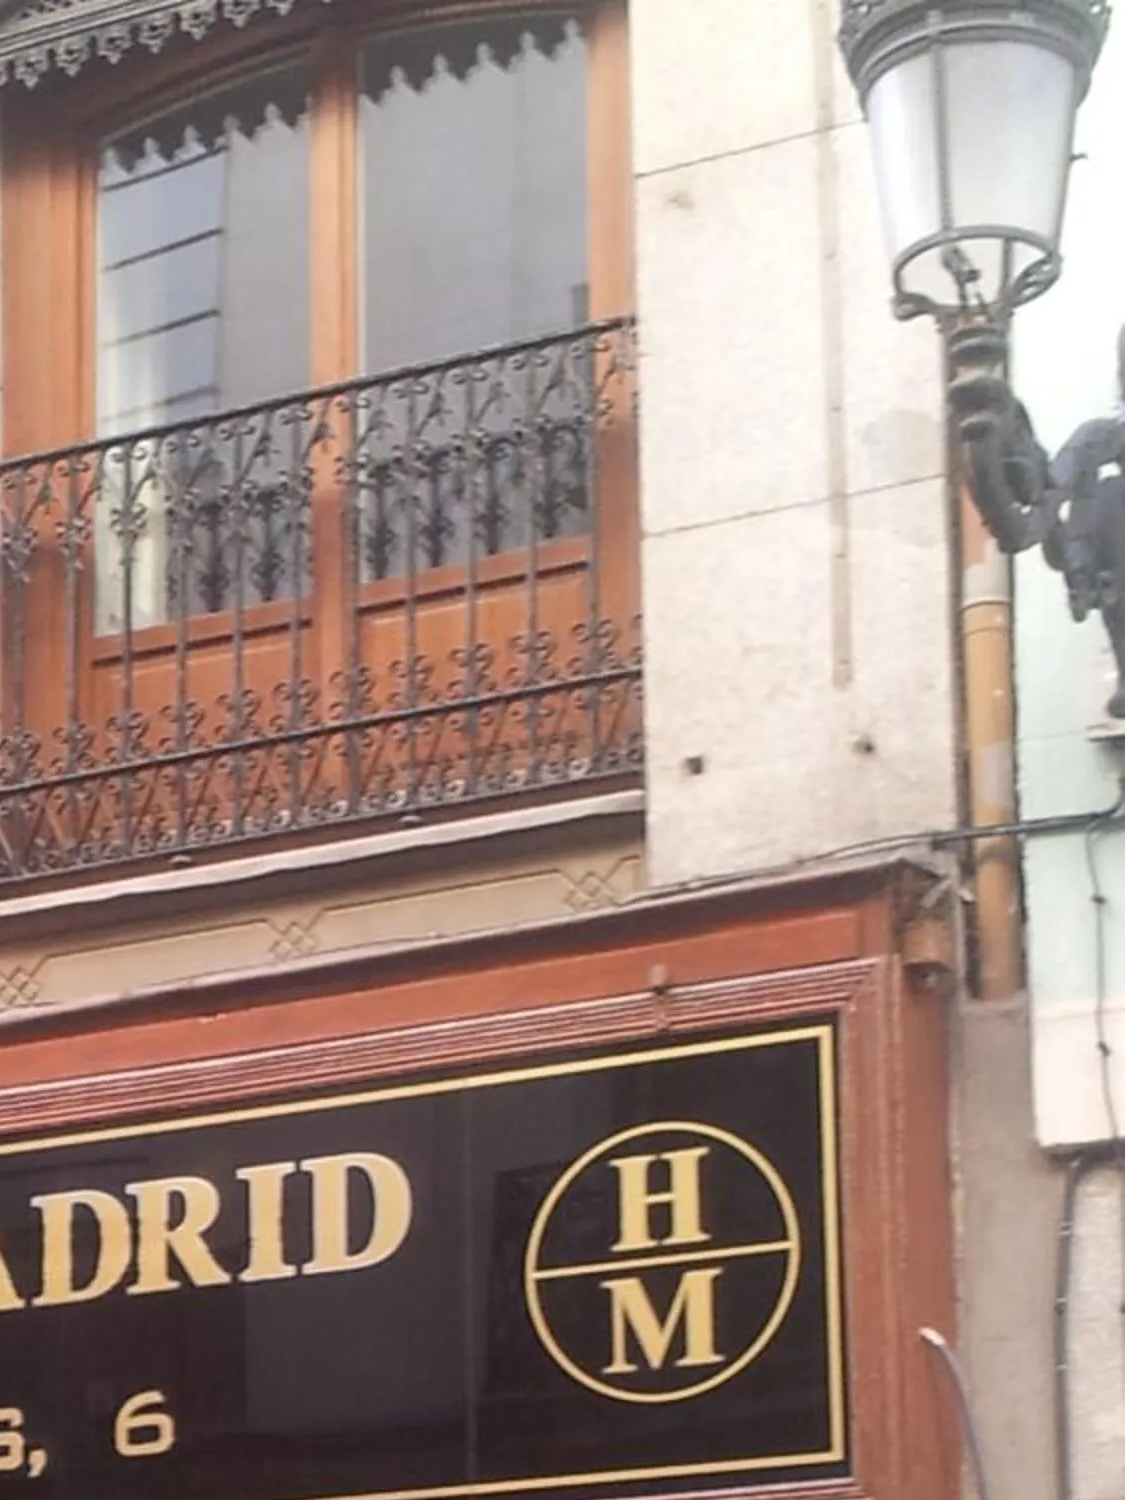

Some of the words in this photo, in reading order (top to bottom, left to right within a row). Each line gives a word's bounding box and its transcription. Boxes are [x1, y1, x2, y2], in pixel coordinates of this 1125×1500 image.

[608, 1146, 712, 1252] H
[599, 1266, 726, 1375] M
[113, 1390, 176, 1458] 6
